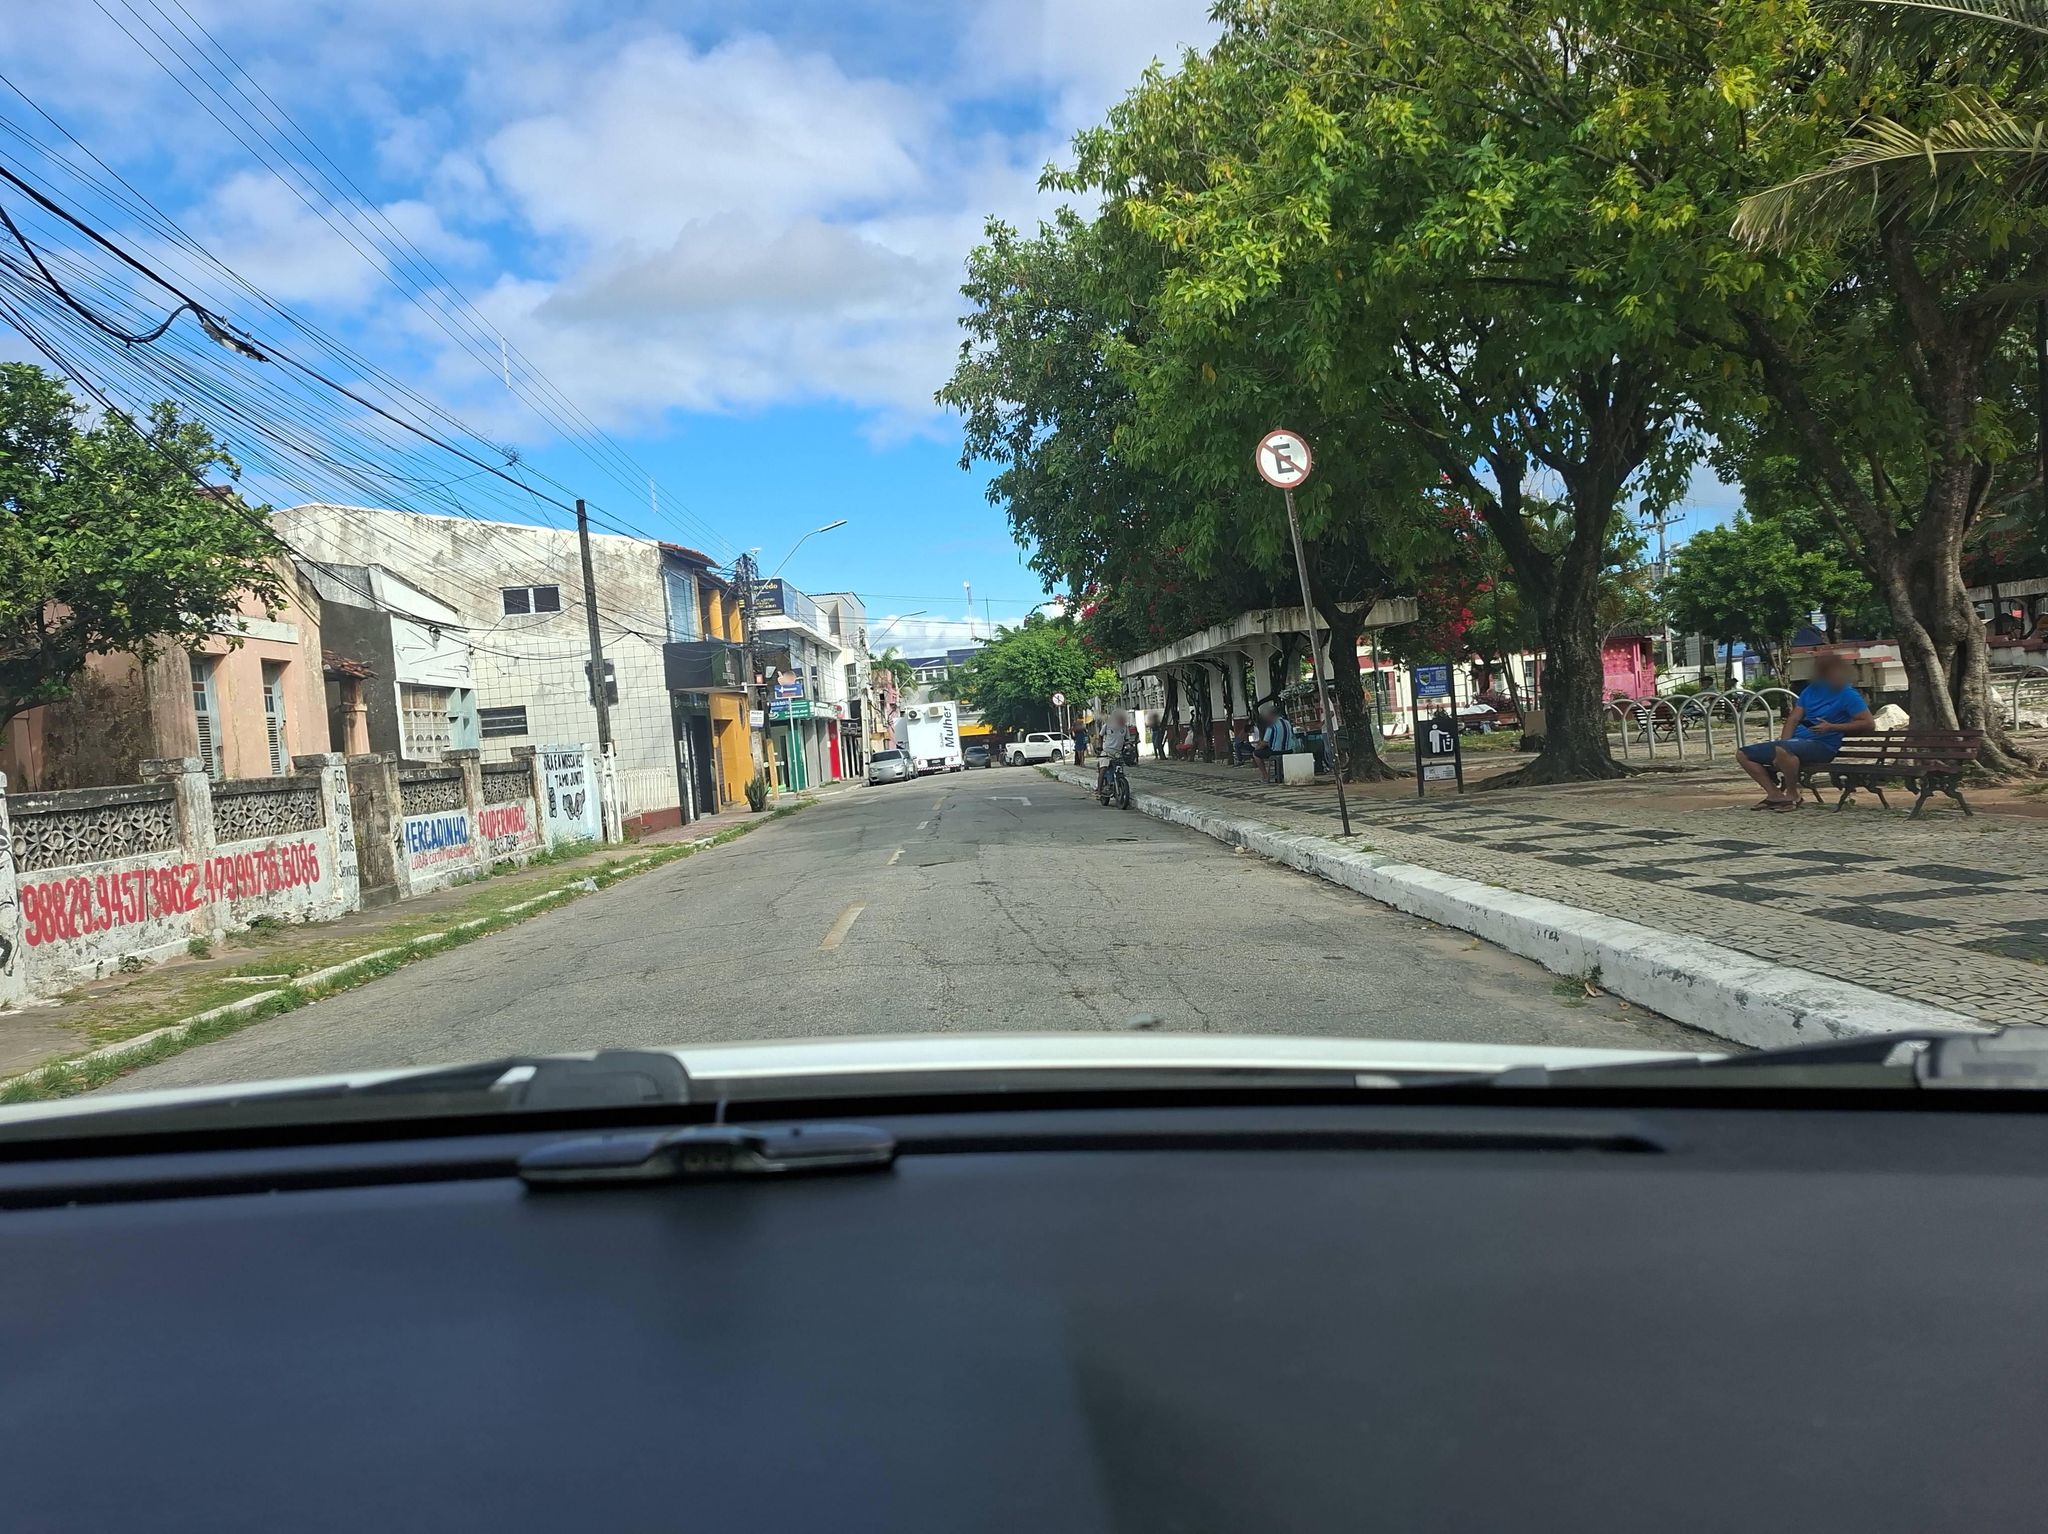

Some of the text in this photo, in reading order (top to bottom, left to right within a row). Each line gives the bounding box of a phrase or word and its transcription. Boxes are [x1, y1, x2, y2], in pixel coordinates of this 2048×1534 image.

[1273, 443, 1294, 474] E
[943, 705, 955, 748] Mulher
[339, 821, 348, 833] de
